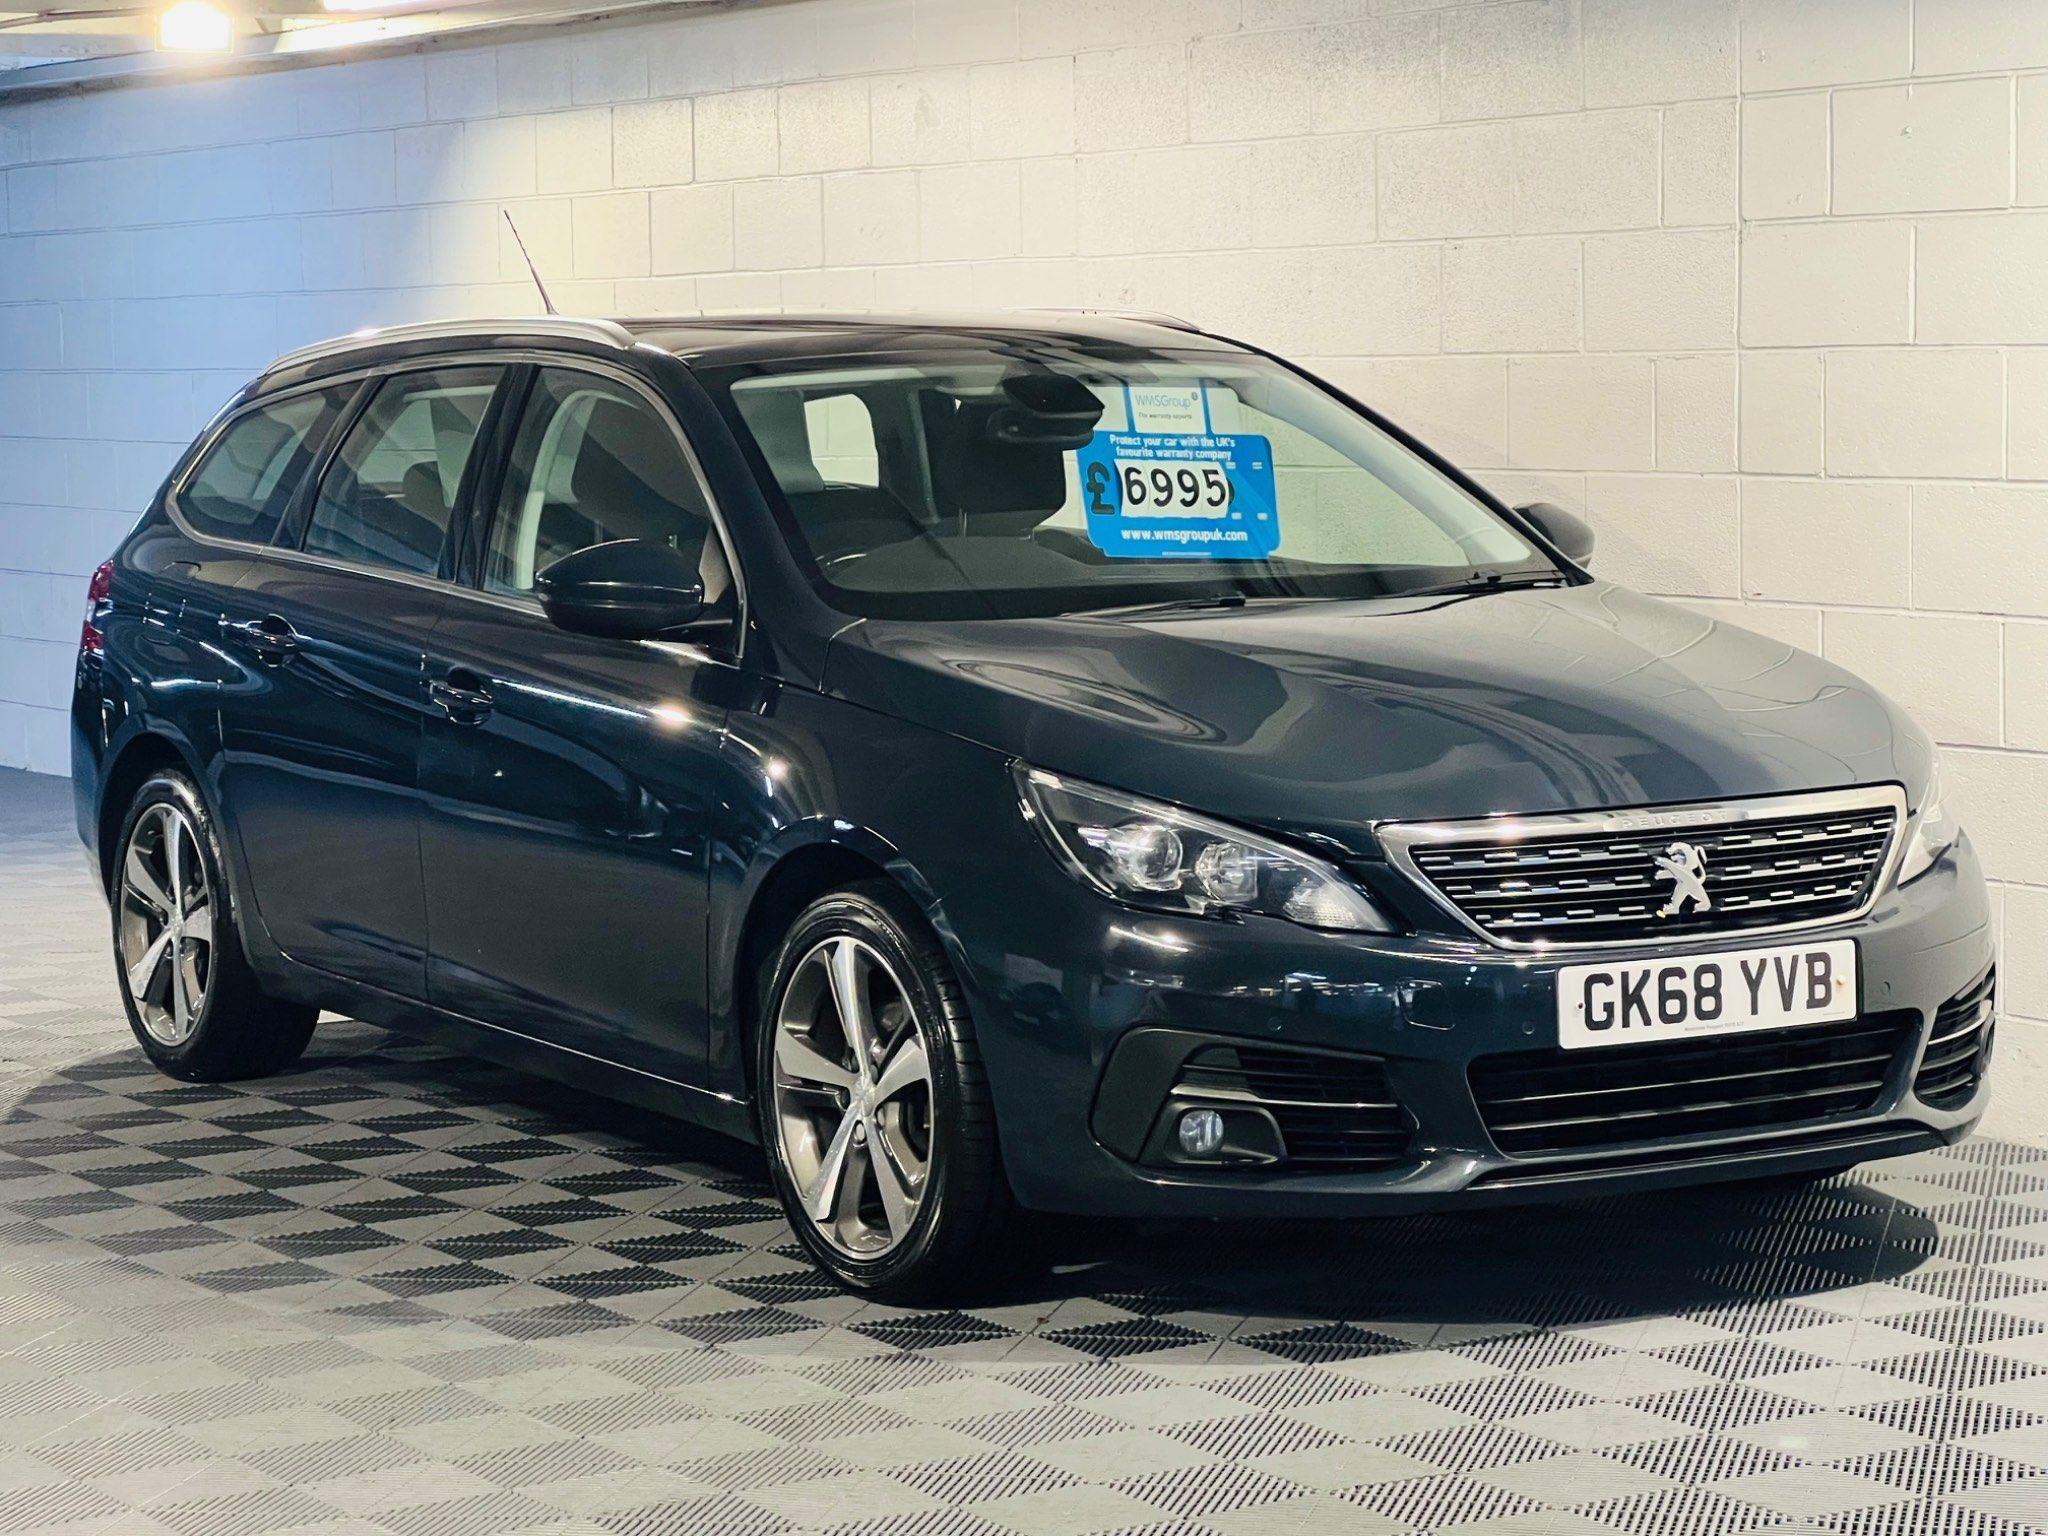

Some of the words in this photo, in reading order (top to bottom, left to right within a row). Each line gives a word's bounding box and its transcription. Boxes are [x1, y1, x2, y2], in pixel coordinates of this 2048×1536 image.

[1135, 394, 1191, 410] WMSGroup
[1109, 434, 1141, 446] Protect
[1143, 437, 1162, 448] your
[1164, 437, 1178, 447] car
[1181, 437, 1199, 447] with
[1201, 437, 1214, 447] the
[1215, 437, 1236, 448] UK's
[1116, 446, 1154, 458] favourite
[1156, 449, 1194, 459] warranty
[1196, 450, 1232, 460] company
[1121, 528, 1248, 544] www.wmsgroupuk.com
[1622, 810, 1727, 828] PEUGEOT
[1584, 963, 1723, 1031] GK68
[1740, 951, 1832, 1016] YVB
